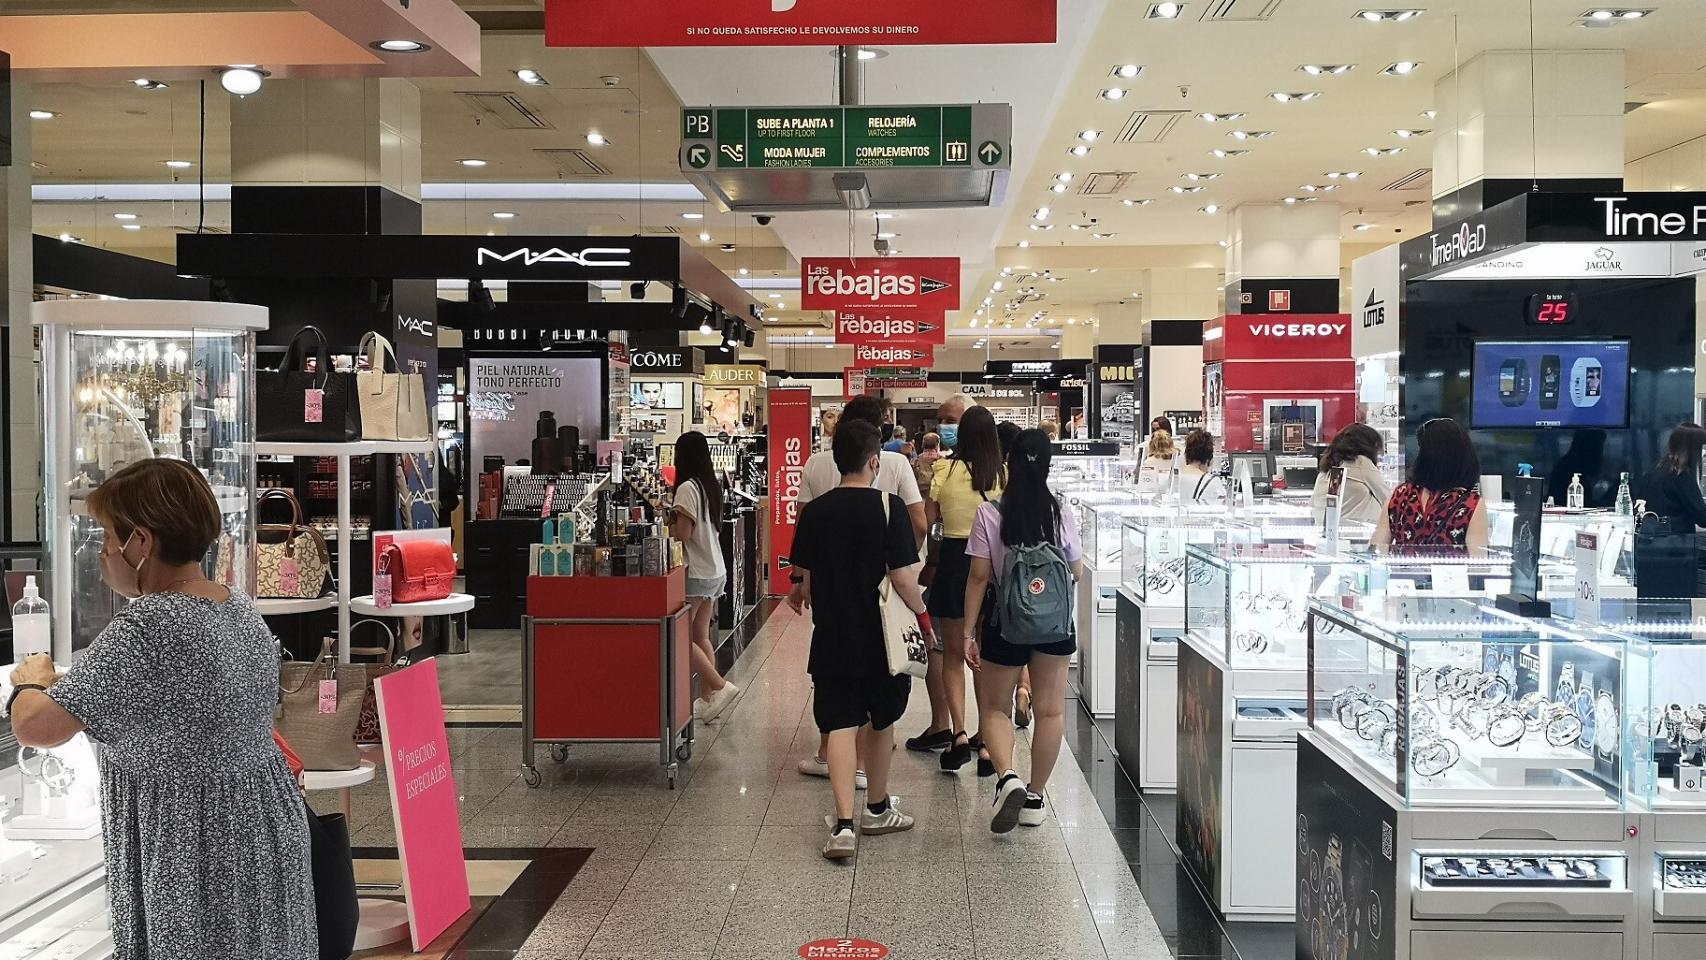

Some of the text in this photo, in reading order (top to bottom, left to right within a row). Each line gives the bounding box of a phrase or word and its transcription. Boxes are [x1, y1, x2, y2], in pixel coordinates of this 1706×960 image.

[686, 26, 919, 35] SI NO QUEDA SATISFECHO LE DEVOLVEMOS SU DINERO
[686, 115, 709, 133] PB
[757, 118, 834, 129] SUBE A PLANTA 1
[868, 114, 917, 128] RELOJERÍA
[795, 129, 816, 137] FLOOR
[868, 129, 897, 137] WATCHES
[764, 147, 826, 158] MODA MUJER
[855, 146, 930, 157] COMPLEMENTOS
[764, 159, 812, 167] FASHION LADIES
[855, 158, 894, 167] ACCESORIES
[1594, 197, 1687, 235] Time
[807, 264, 829, 275] Las
[1585, 261, 1623, 271] JAGUAR
[807, 269, 916, 301] rebajas
[839, 312, 855, 320] Las
[1363, 307, 1385, 328] LOTUS
[1538, 303, 1568, 321] 25
[839, 316, 915, 337] rebajas
[1249, 323, 1347, 336] VICEROY
[630, 351, 682, 367] CÔME
[857, 346, 912, 363] rebajas
[477, 365, 551, 376] PIEL NATURAL
[477, 376, 561, 388] TONO PERFECTO
[961, 385, 986, 394] CAJA
[1008, 389, 1025, 397] SOL
[1061, 443, 1090, 451] FOSSIL
[781, 437, 803, 525] rebajas
[1397, 664, 1406, 753] REBAJAS
[405, 740, 438, 771] PRECIOS
[405, 762, 448, 800] ESPECIALES
[808, 946, 881, 954] Metros
